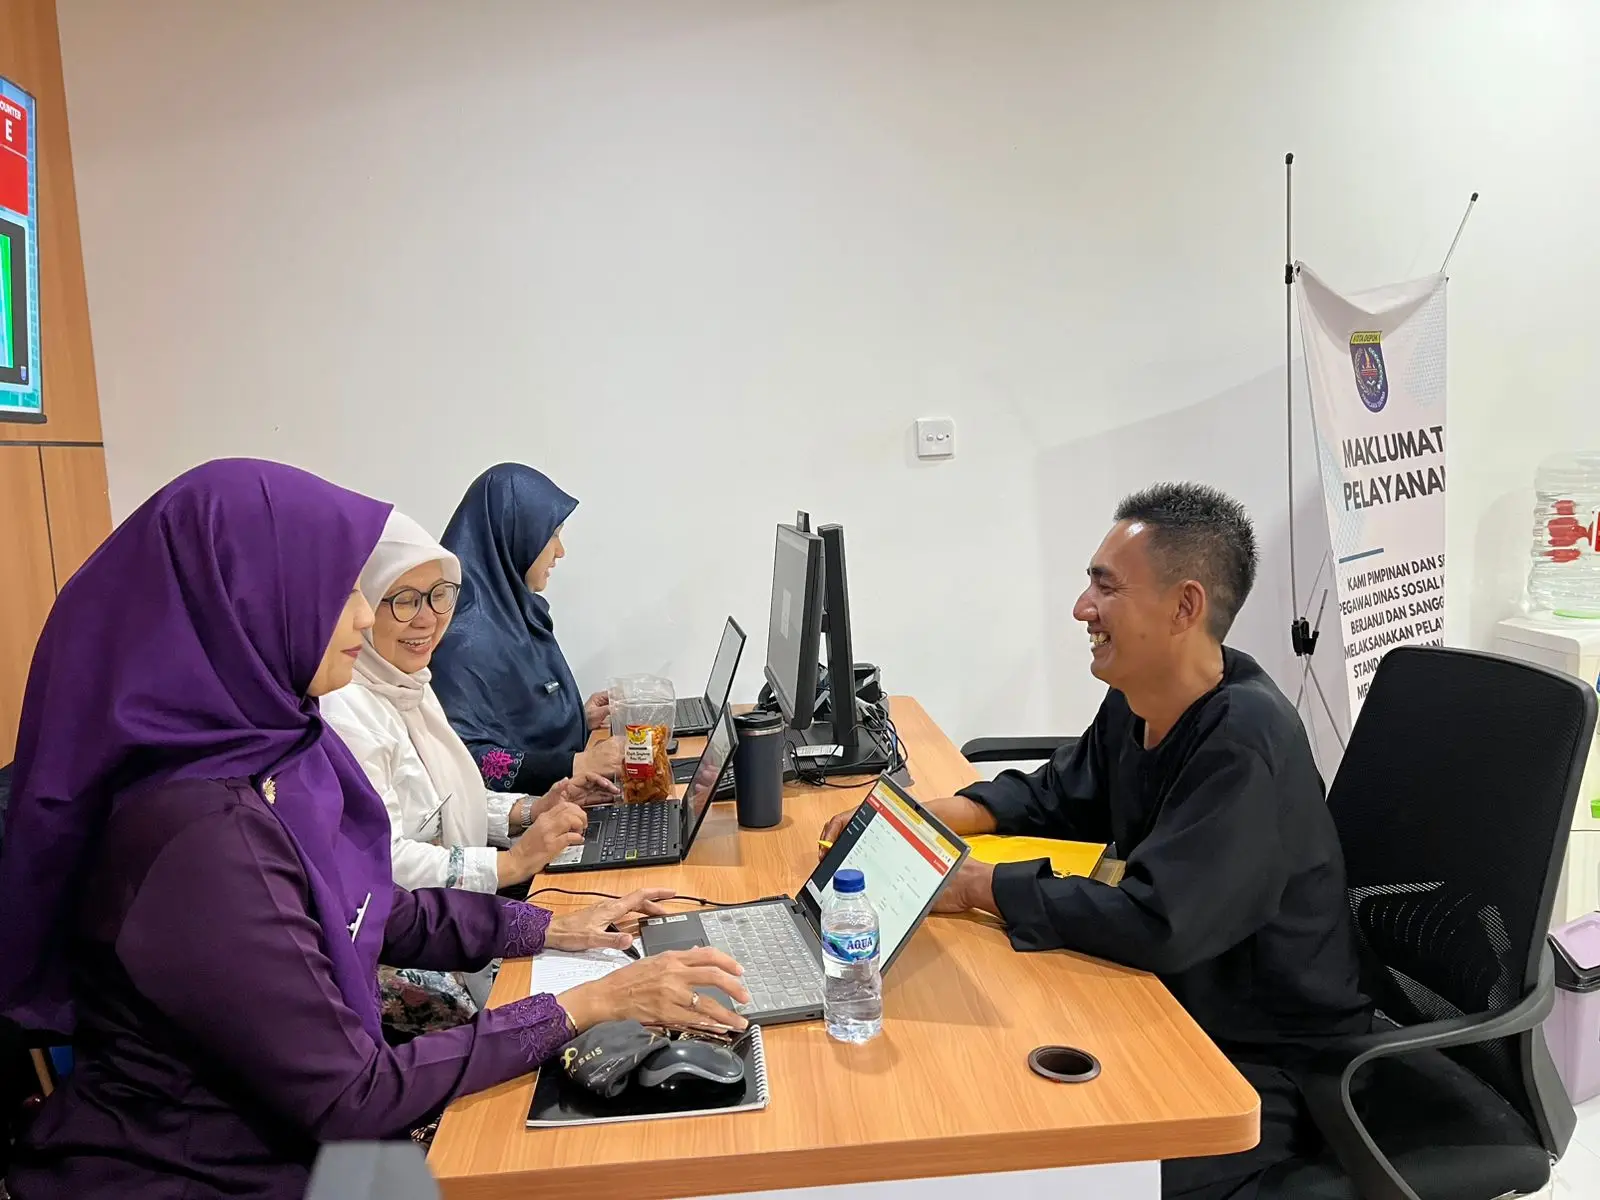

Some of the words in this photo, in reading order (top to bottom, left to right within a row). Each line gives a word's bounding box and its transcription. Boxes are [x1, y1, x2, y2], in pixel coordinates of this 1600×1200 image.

[5, 118, 12, 142] E
[1342, 426, 1444, 468] MAKLUMAT
[1347, 573, 1366, 592] KAMI
[1367, 562, 1410, 586] PIMPINAN
[1411, 556, 1437, 574] DAN
[1372, 586, 1400, 606] DINAS
[1401, 576, 1440, 597] SOSIAL
[1350, 611, 1385, 635] BERJANJI
[1386, 605, 1407, 623] DAN
[1344, 624, 1414, 660] MELAKSANAKAN
[1353, 655, 1383, 679] STAND
[846, 936, 873, 951] AQUA
